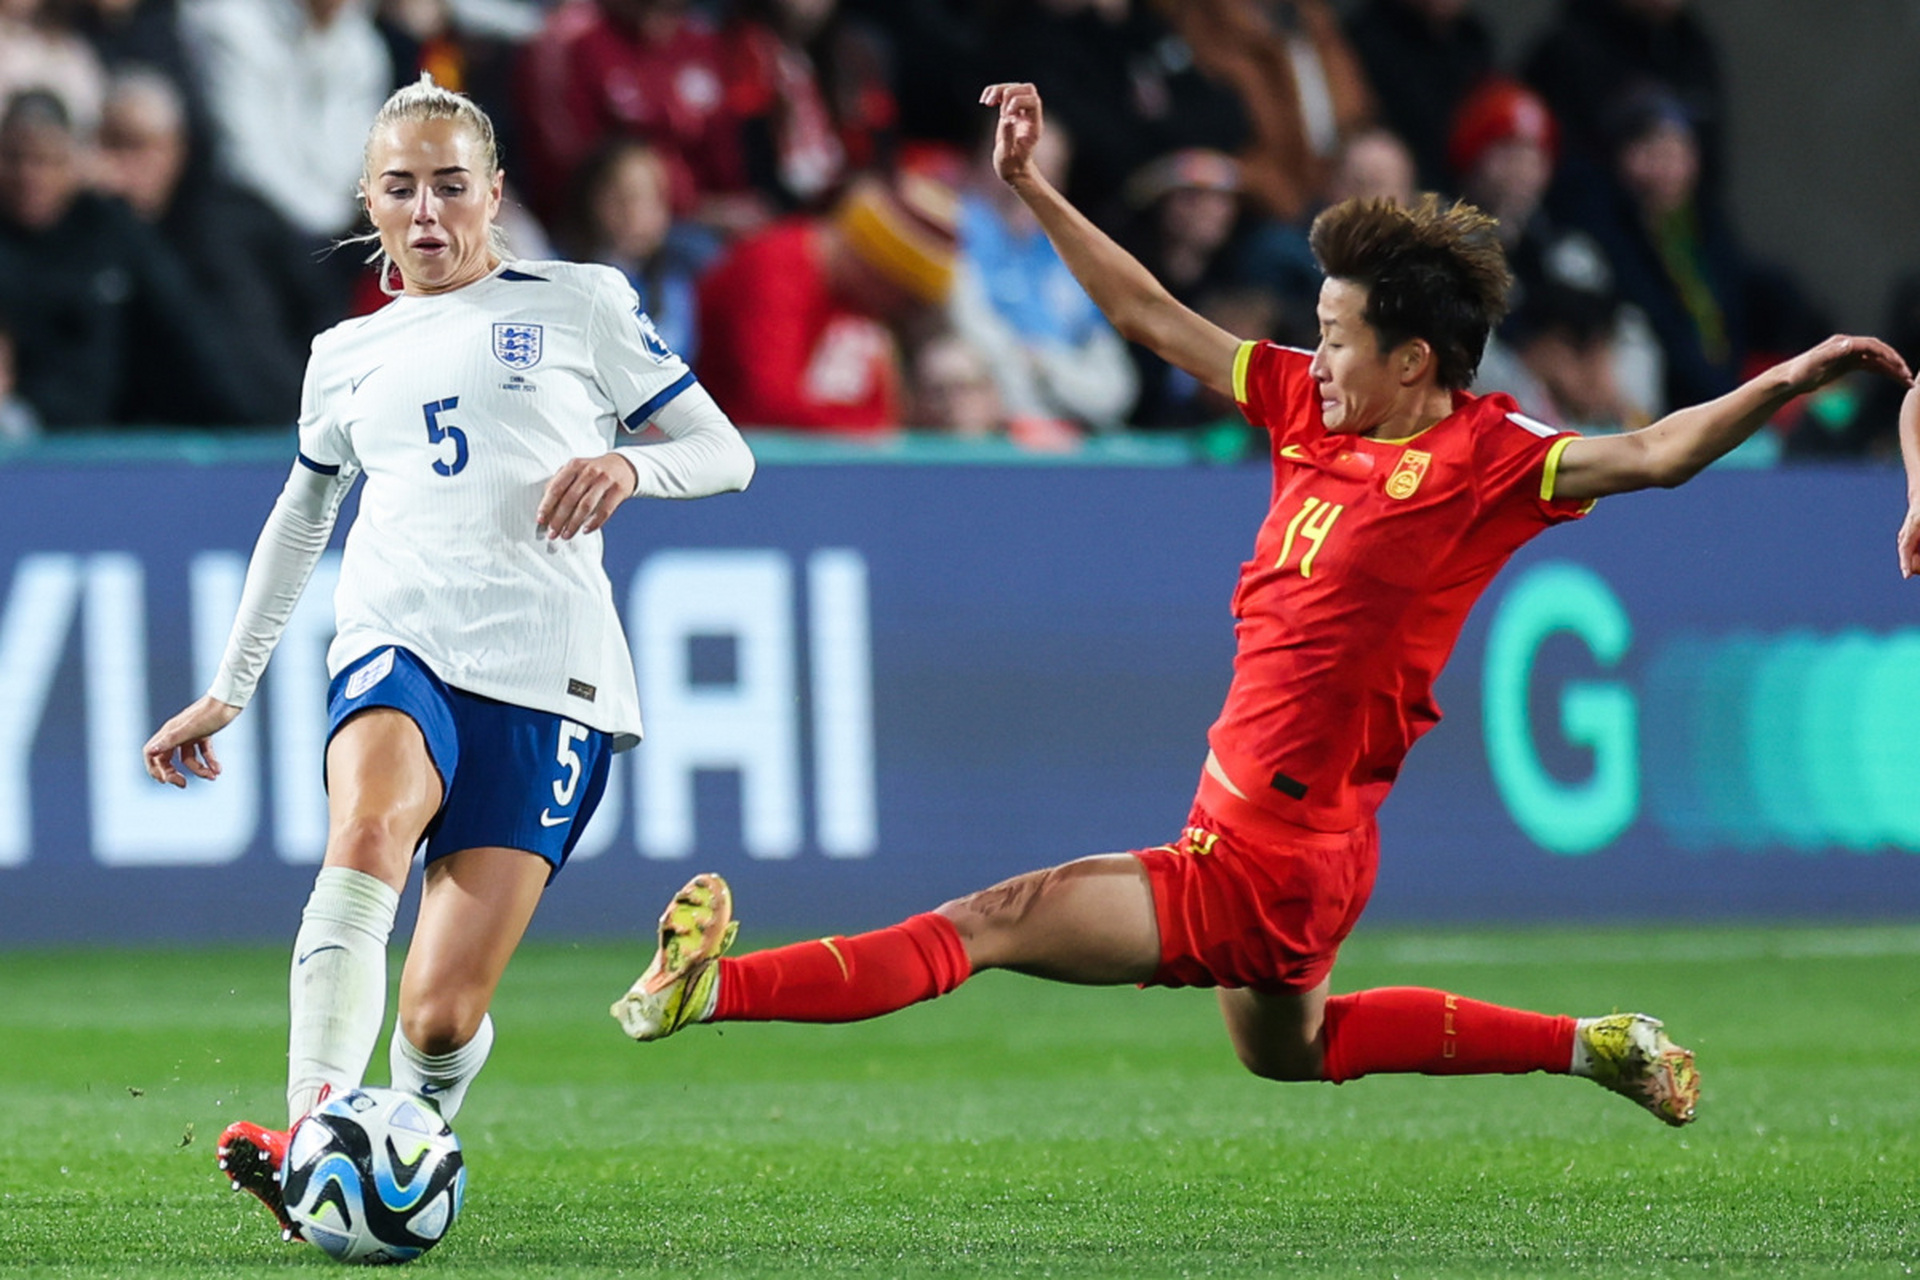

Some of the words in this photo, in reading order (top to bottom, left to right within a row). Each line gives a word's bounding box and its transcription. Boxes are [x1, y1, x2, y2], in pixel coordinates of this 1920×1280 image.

[422, 395, 469, 477] 5
[1274, 496, 1344, 579] 14
[0, 550, 880, 866] YUAI
[1481, 560, 1641, 855] G
[552, 719, 590, 807] 5
